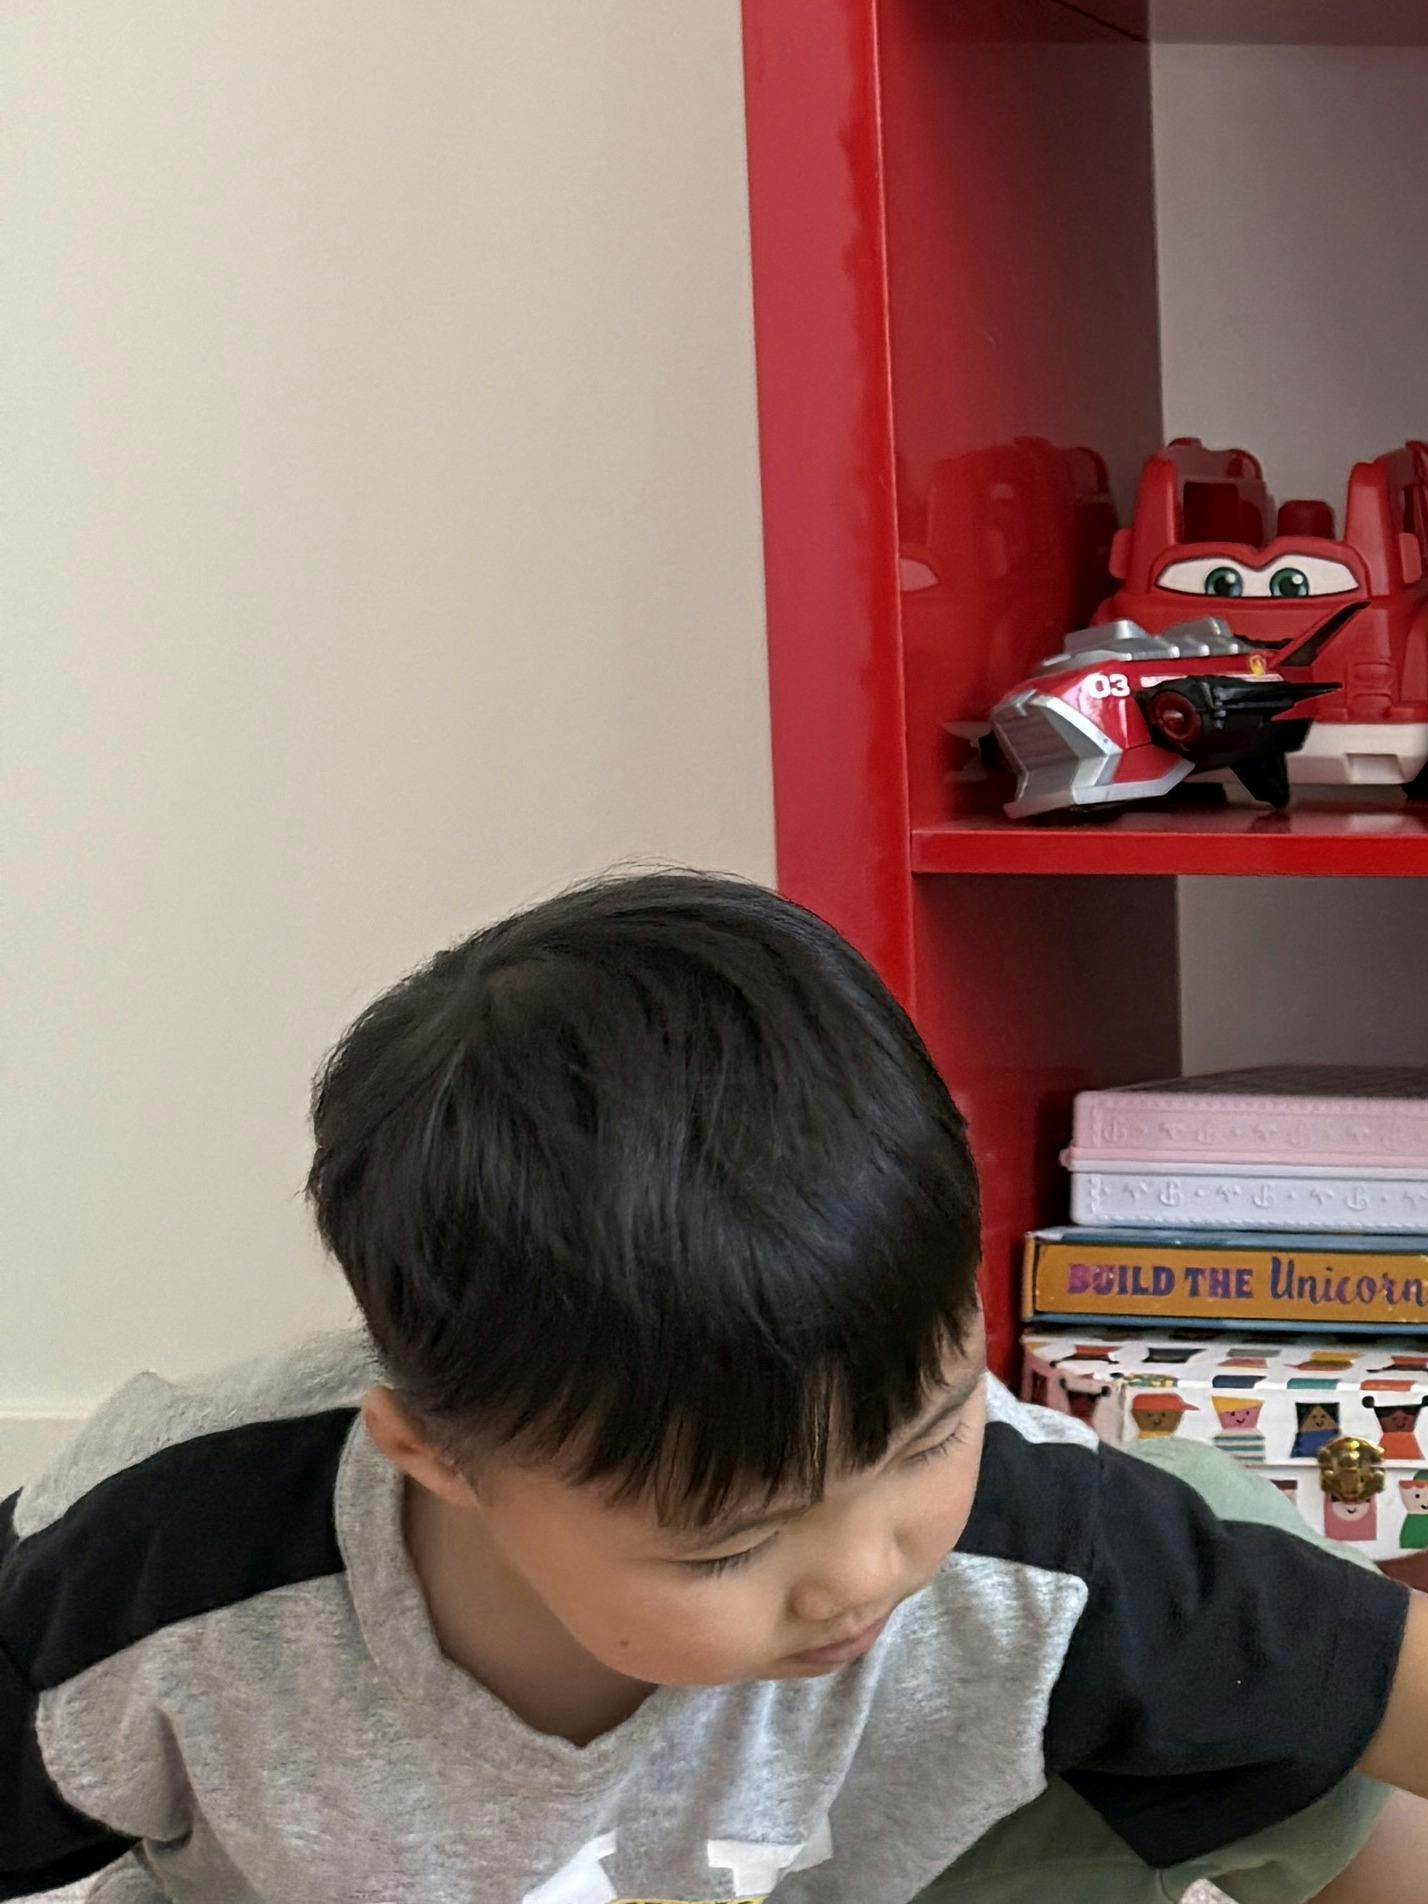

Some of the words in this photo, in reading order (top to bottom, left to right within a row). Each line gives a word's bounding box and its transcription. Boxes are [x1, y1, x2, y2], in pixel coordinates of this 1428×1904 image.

[1089, 672, 1130, 699] 03
[1066, 1263, 1176, 1296] BUILD
[1184, 1267, 1254, 1299] THE
